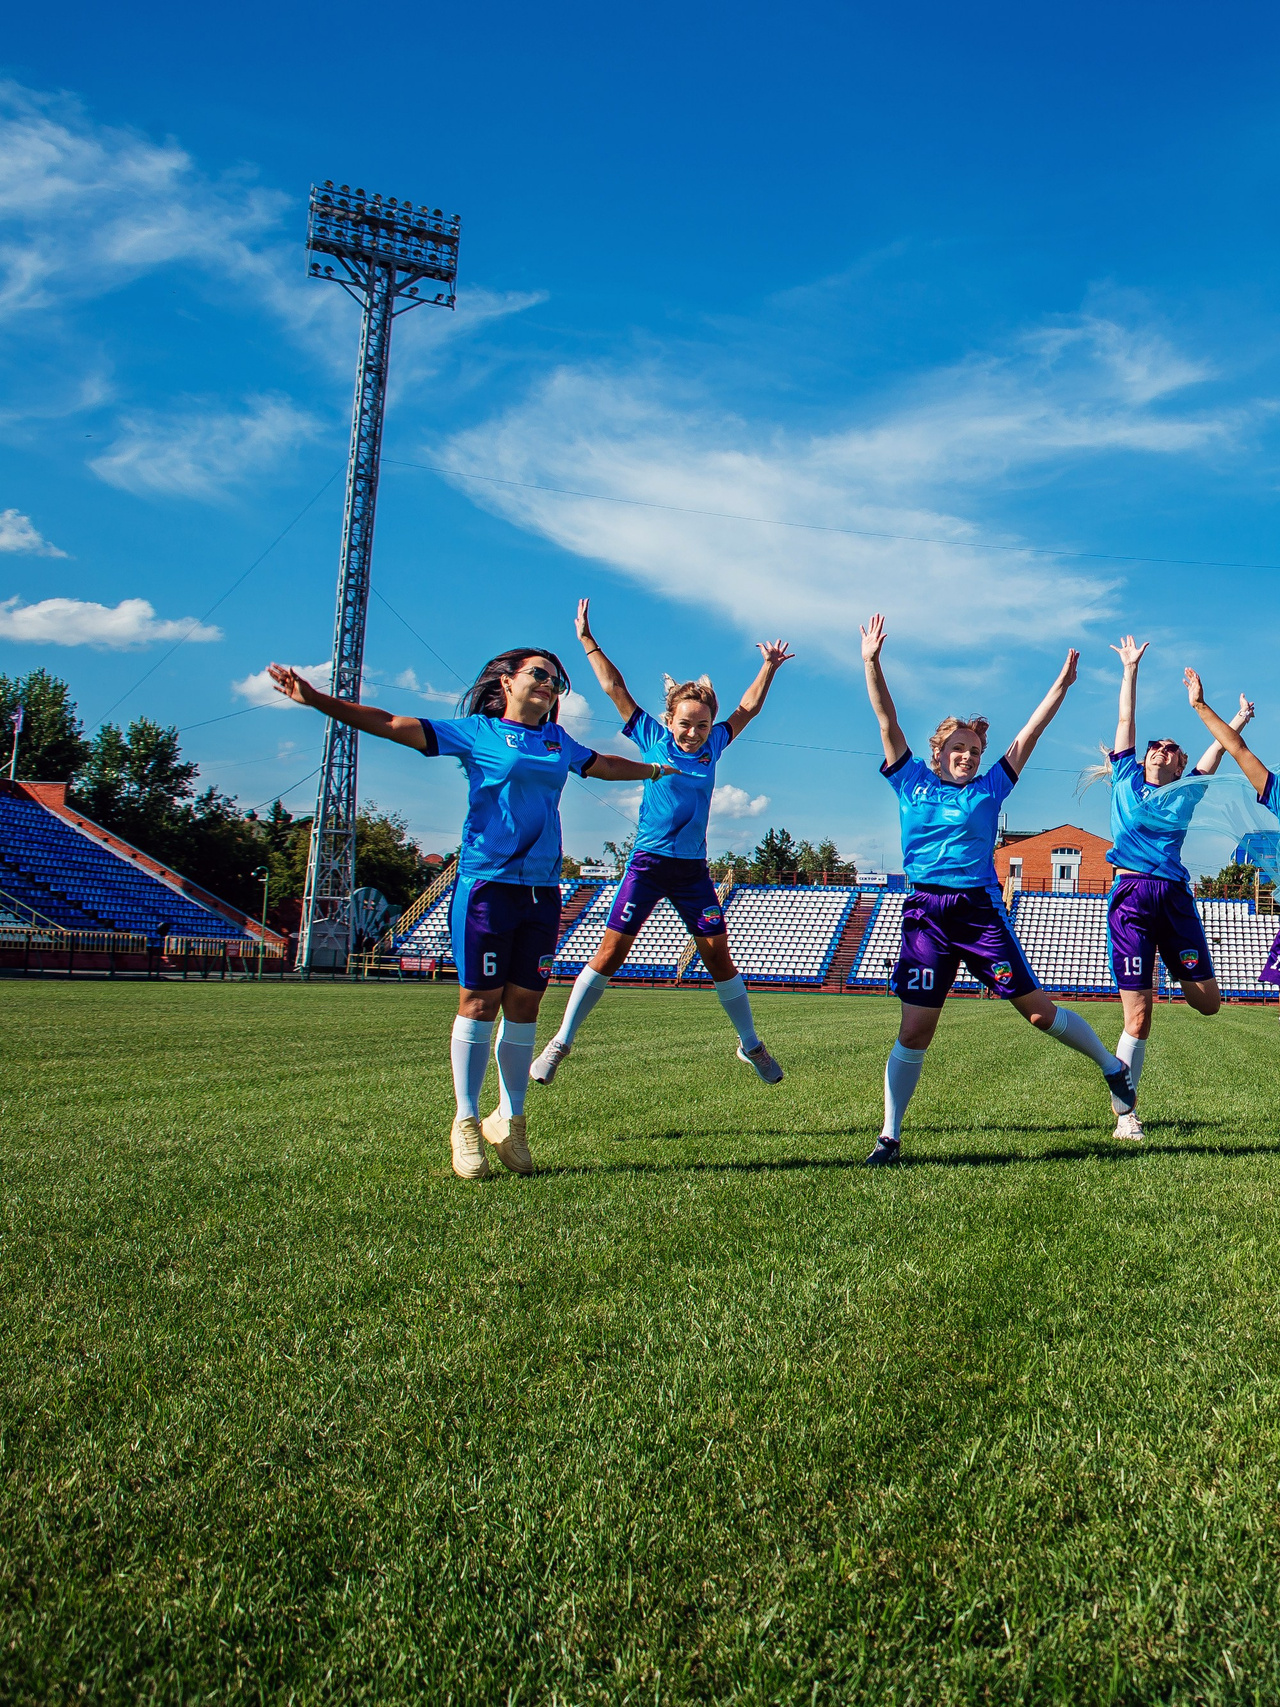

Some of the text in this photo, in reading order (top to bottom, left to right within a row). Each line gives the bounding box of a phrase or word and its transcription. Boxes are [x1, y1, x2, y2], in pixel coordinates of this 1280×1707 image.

[620, 901, 637, 922] 5
[483, 952, 497, 976] 6
[1123, 956, 1142, 976] 19
[907, 968, 934, 990] 20
